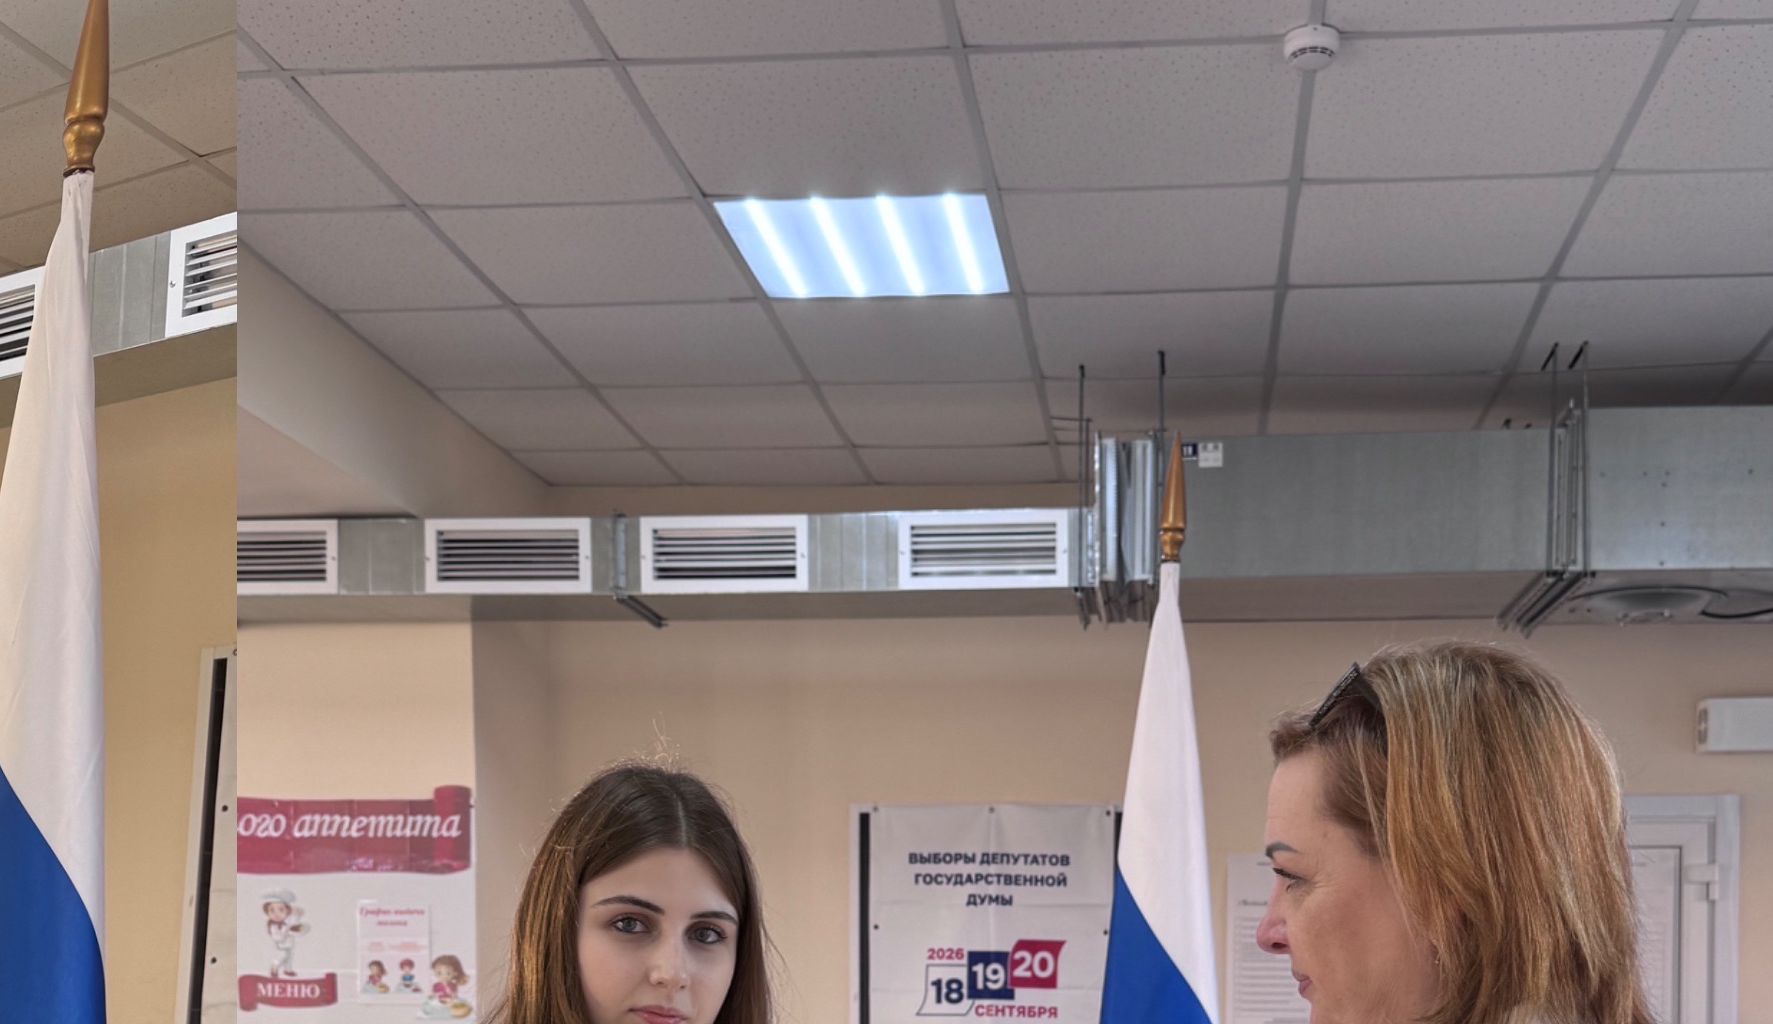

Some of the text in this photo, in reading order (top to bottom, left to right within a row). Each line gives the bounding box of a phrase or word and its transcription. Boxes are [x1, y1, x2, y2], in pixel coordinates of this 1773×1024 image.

[237, 813, 462, 838] ого аппетита
[908, 852, 1070, 867] ВЫБОРЫ ДЕПУТАТОВ
[914, 872, 1068, 887] ГОСУДАРСТВЕННОЙ
[966, 894, 1014, 907] ДУМЫ
[927, 948, 965, 960] 2026
[930, 950, 1055, 1004] 18 19 20
[257, 982, 321, 998] МЕНЮ
[974, 1004, 1058, 1018] СЕНТЯБРЯ
